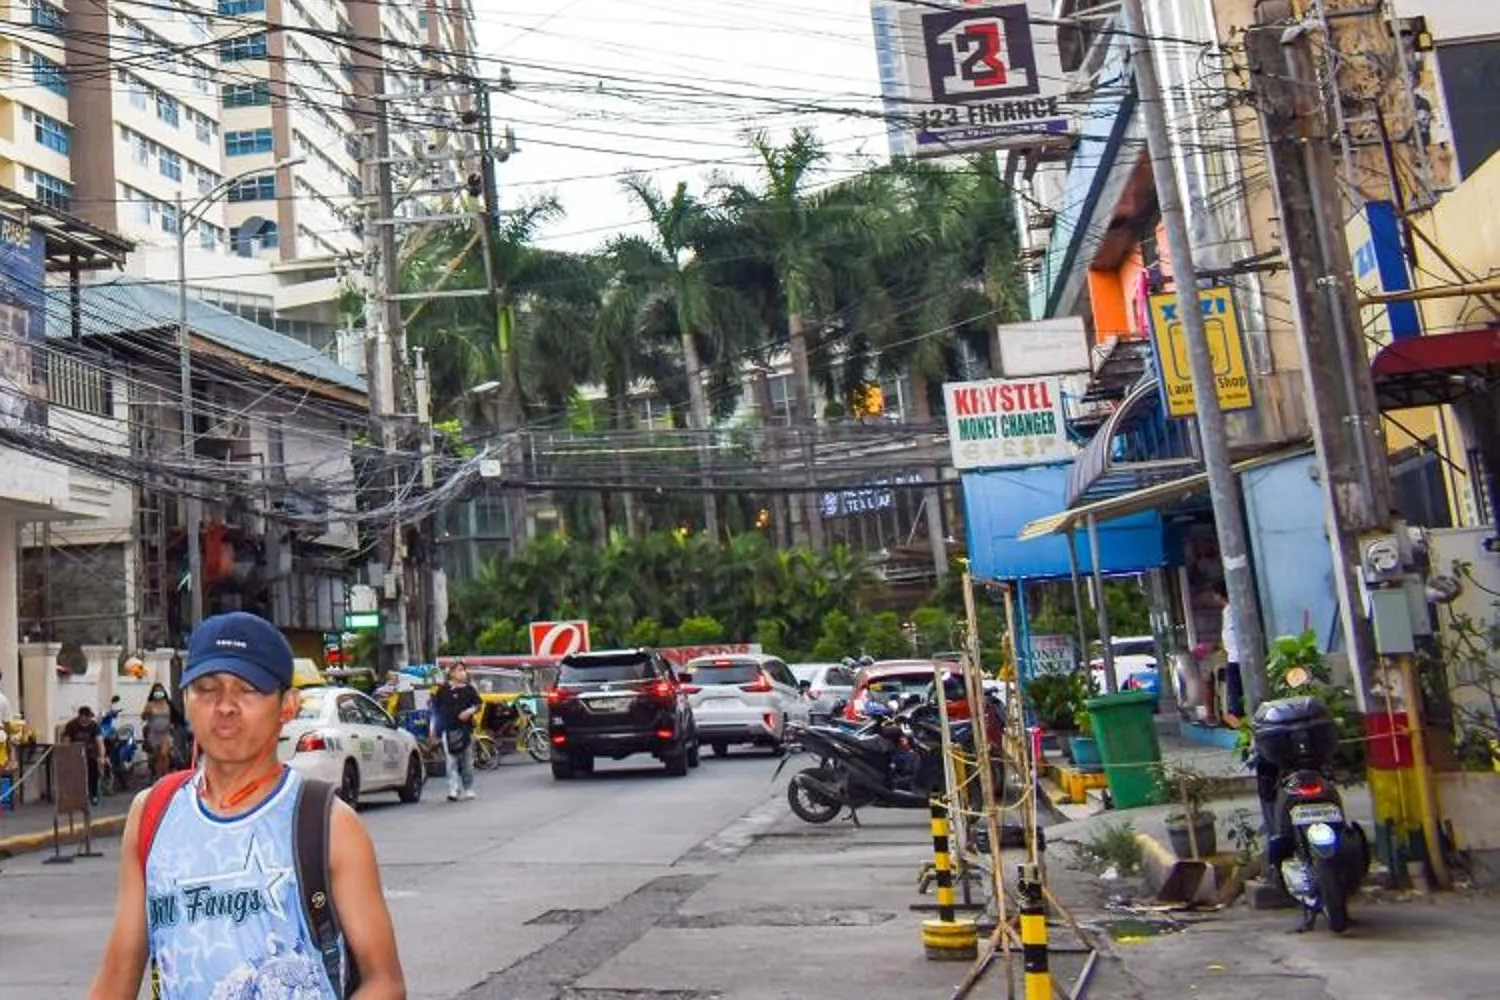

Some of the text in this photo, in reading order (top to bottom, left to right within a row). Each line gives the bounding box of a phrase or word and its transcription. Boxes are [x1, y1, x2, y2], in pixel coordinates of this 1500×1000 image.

[918, 107, 957, 130] 123
[967, 96, 1058, 125] FINANCE
[958, 411, 1057, 440] MONEY CHANGER
